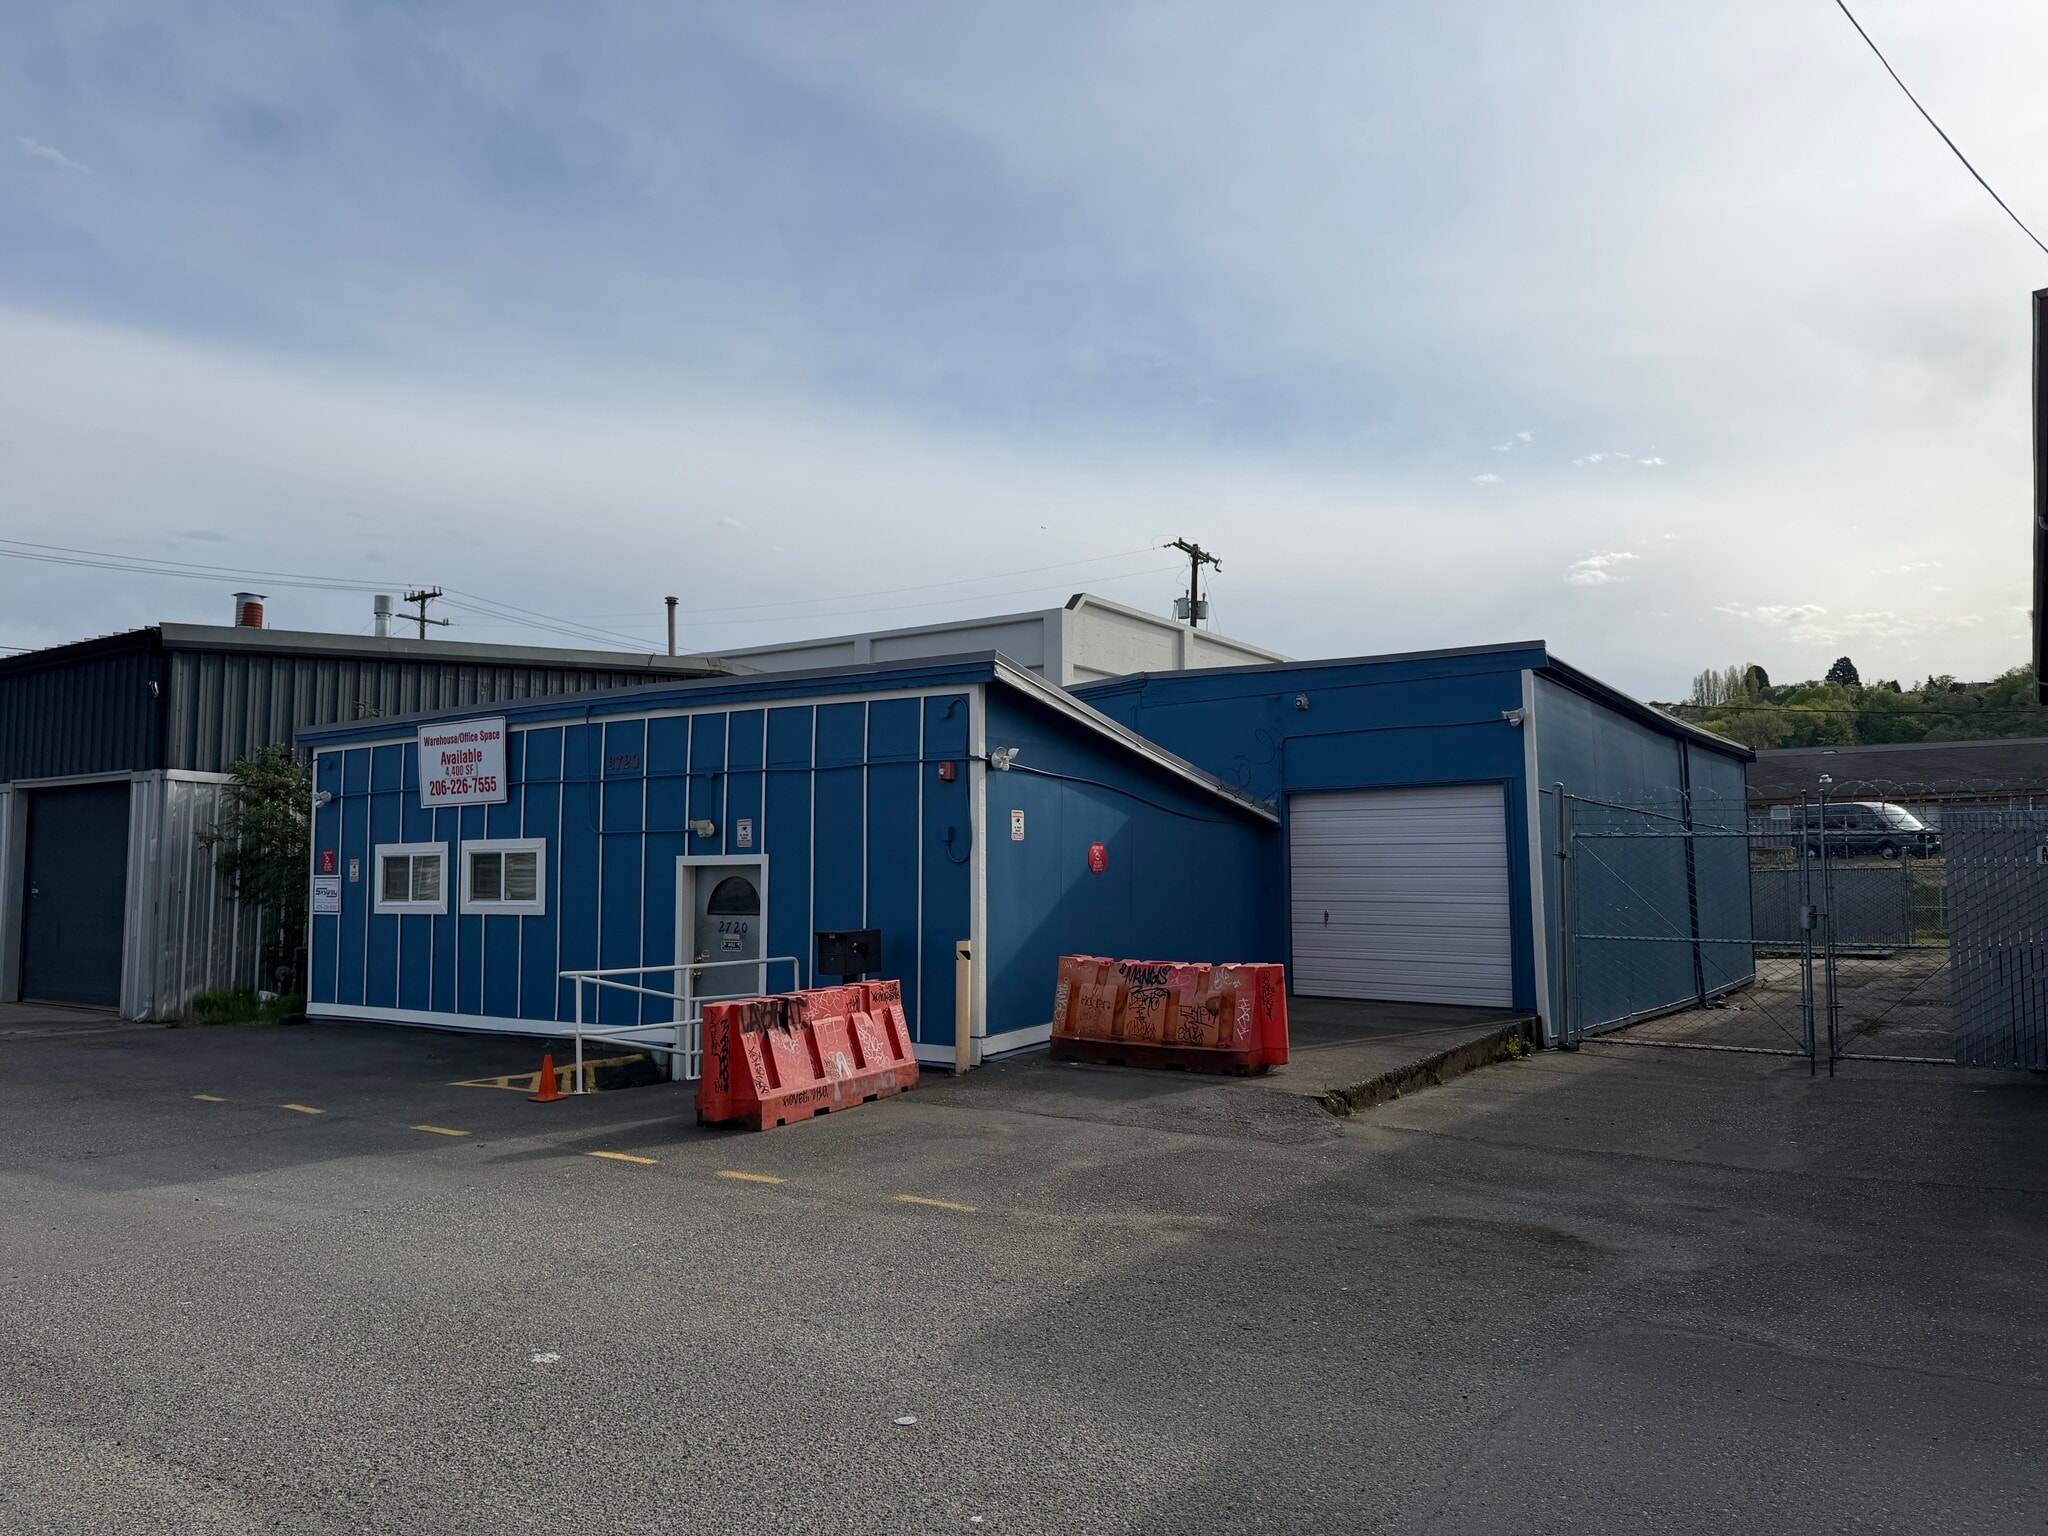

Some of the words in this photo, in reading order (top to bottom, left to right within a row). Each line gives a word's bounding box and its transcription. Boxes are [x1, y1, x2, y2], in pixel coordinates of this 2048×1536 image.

[424, 732, 478, 747] Warehouse/Office
[479, 730, 500, 743] Space
[440, 748, 482, 765] Available
[445, 765, 463, 777] 4,400
[465, 764, 474, 775] SF
[429, 776, 497, 796] 206-226-7555
[719, 920, 748, 933] 2720
